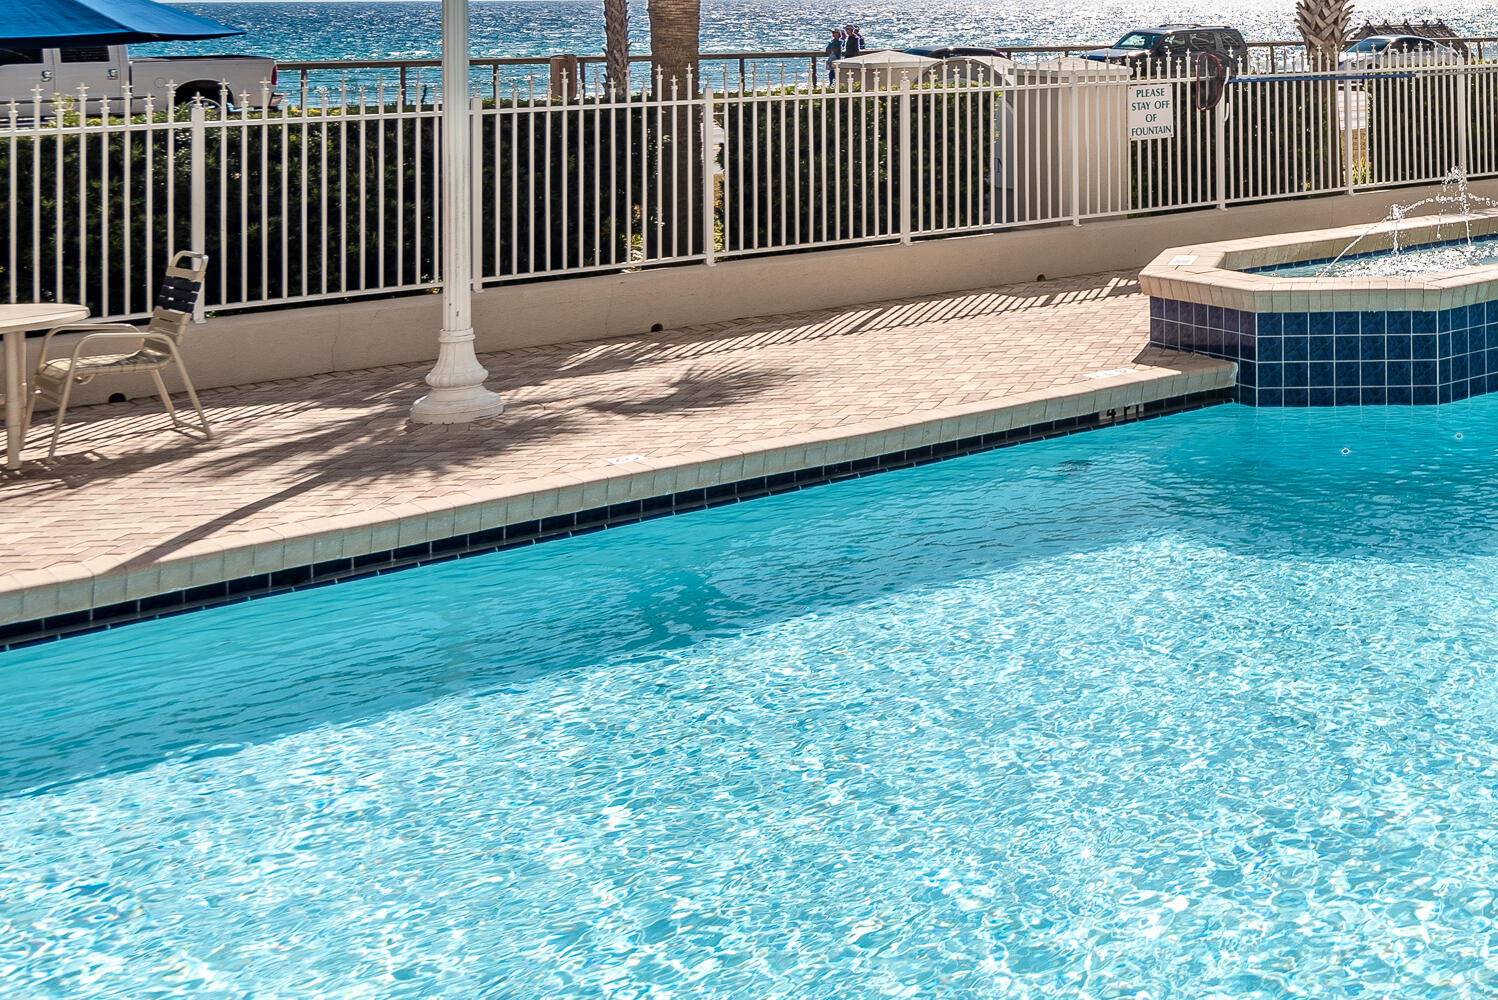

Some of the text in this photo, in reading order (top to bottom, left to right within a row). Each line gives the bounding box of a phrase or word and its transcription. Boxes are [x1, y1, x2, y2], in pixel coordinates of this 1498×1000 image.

[1136, 88, 1165, 98] PLEASE
[1132, 100, 1170, 111] STAY OFF
[1145, 114, 1157, 122] OF
[1132, 125, 1171, 136] FOUNTAIN
[1107, 408, 1116, 418] 4
